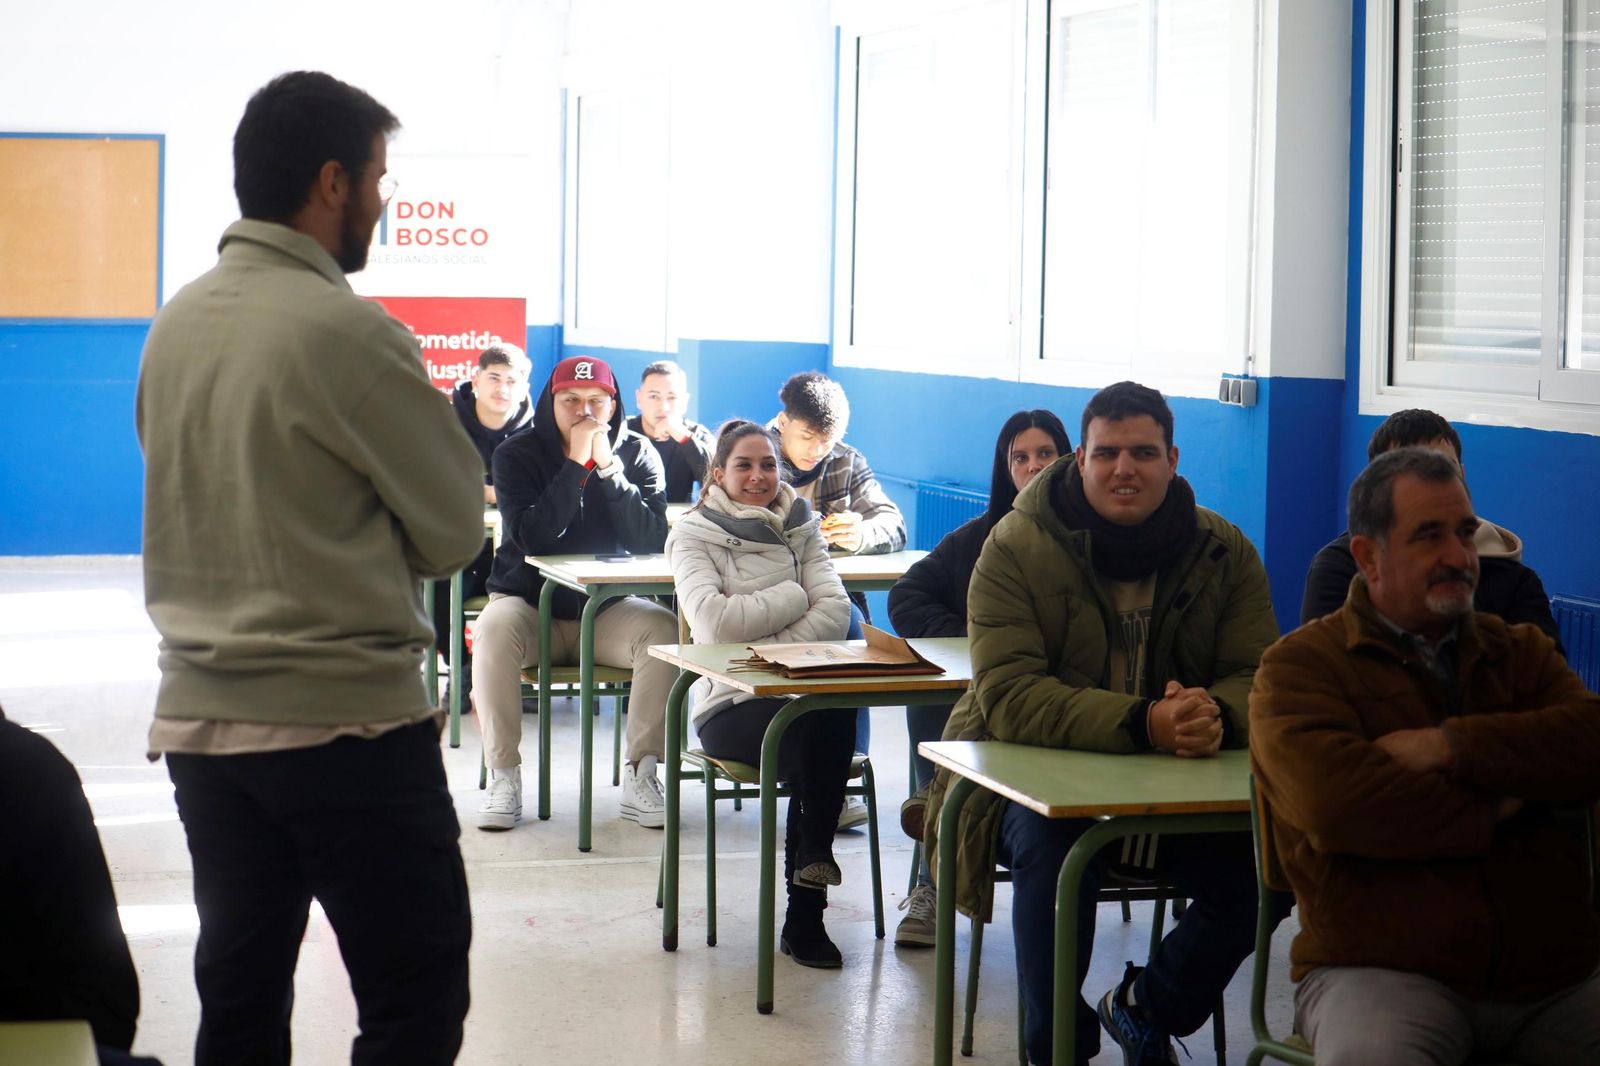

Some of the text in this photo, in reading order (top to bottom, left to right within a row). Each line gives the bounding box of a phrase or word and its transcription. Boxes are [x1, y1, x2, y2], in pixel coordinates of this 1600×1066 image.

[396, 201, 454, 219] DON
[396, 228, 489, 246] BOSCO
[368, 254, 488, 265] ALESIANOS SOCIAL
[415, 330, 503, 350] ometida
[426, 360, 481, 381] justic
